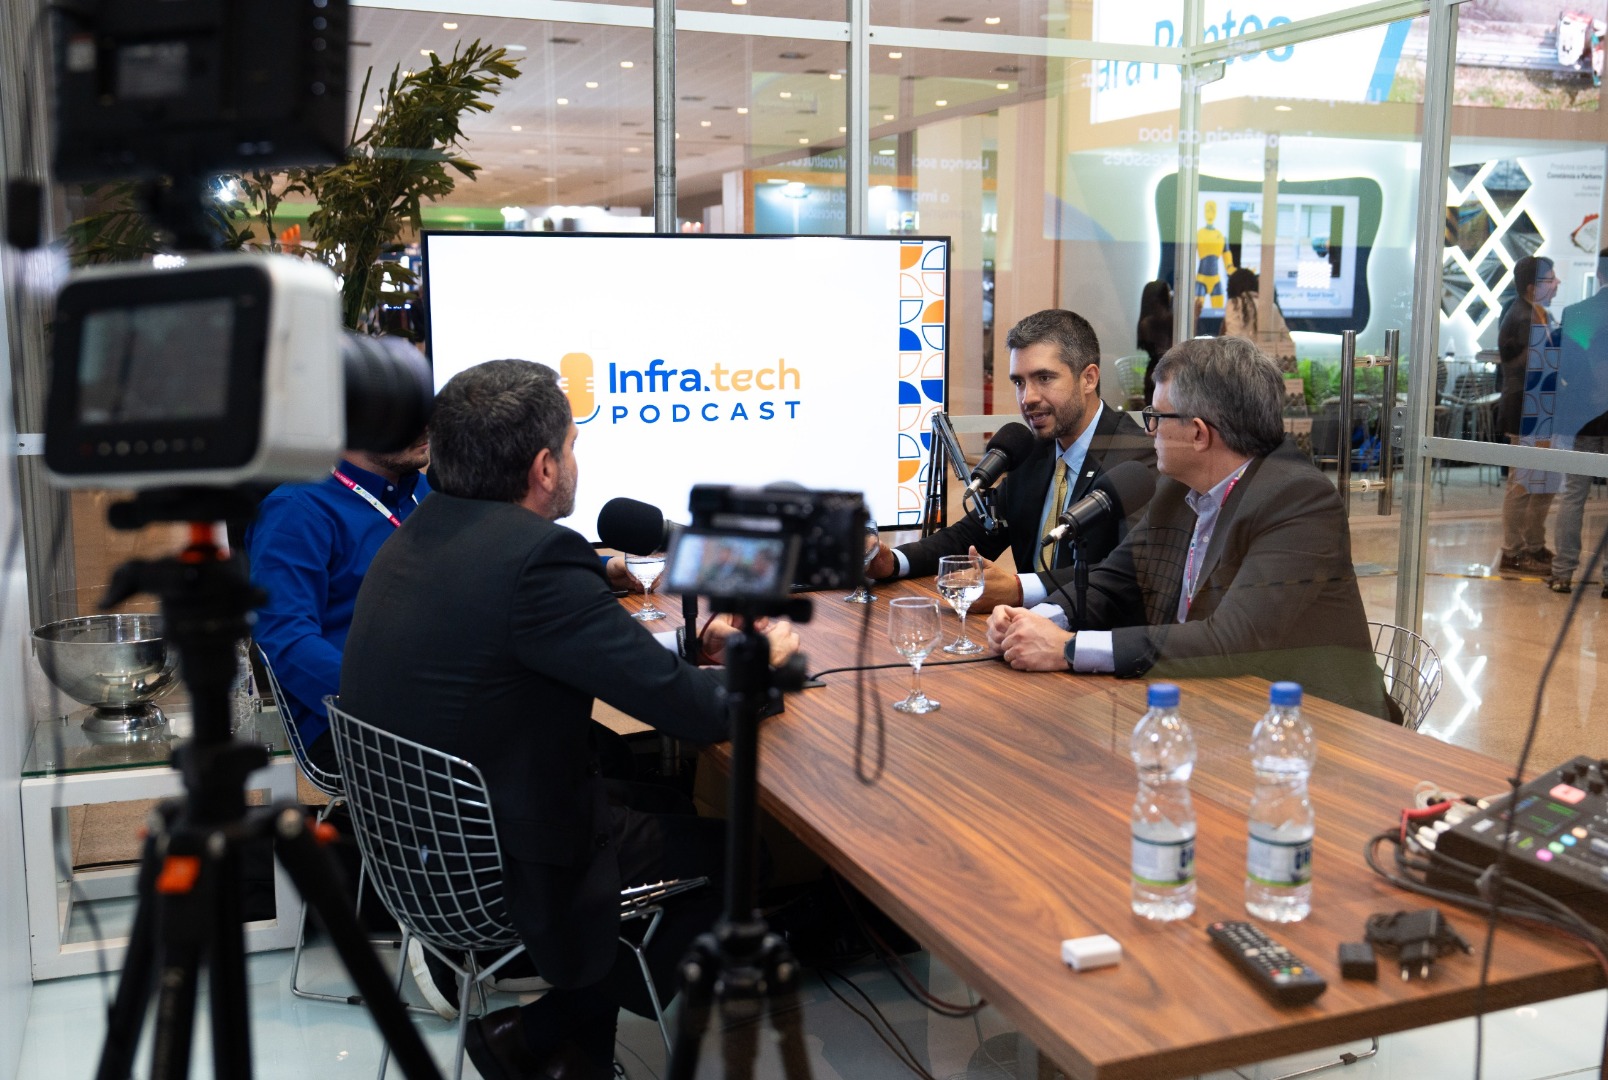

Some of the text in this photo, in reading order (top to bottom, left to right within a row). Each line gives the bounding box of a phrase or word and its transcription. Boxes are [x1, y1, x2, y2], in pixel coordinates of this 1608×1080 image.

[1153, 9, 1295, 80] Pnts
[608, 358, 801, 394] Infra.tech
[612, 401, 801, 424] PODCAST
